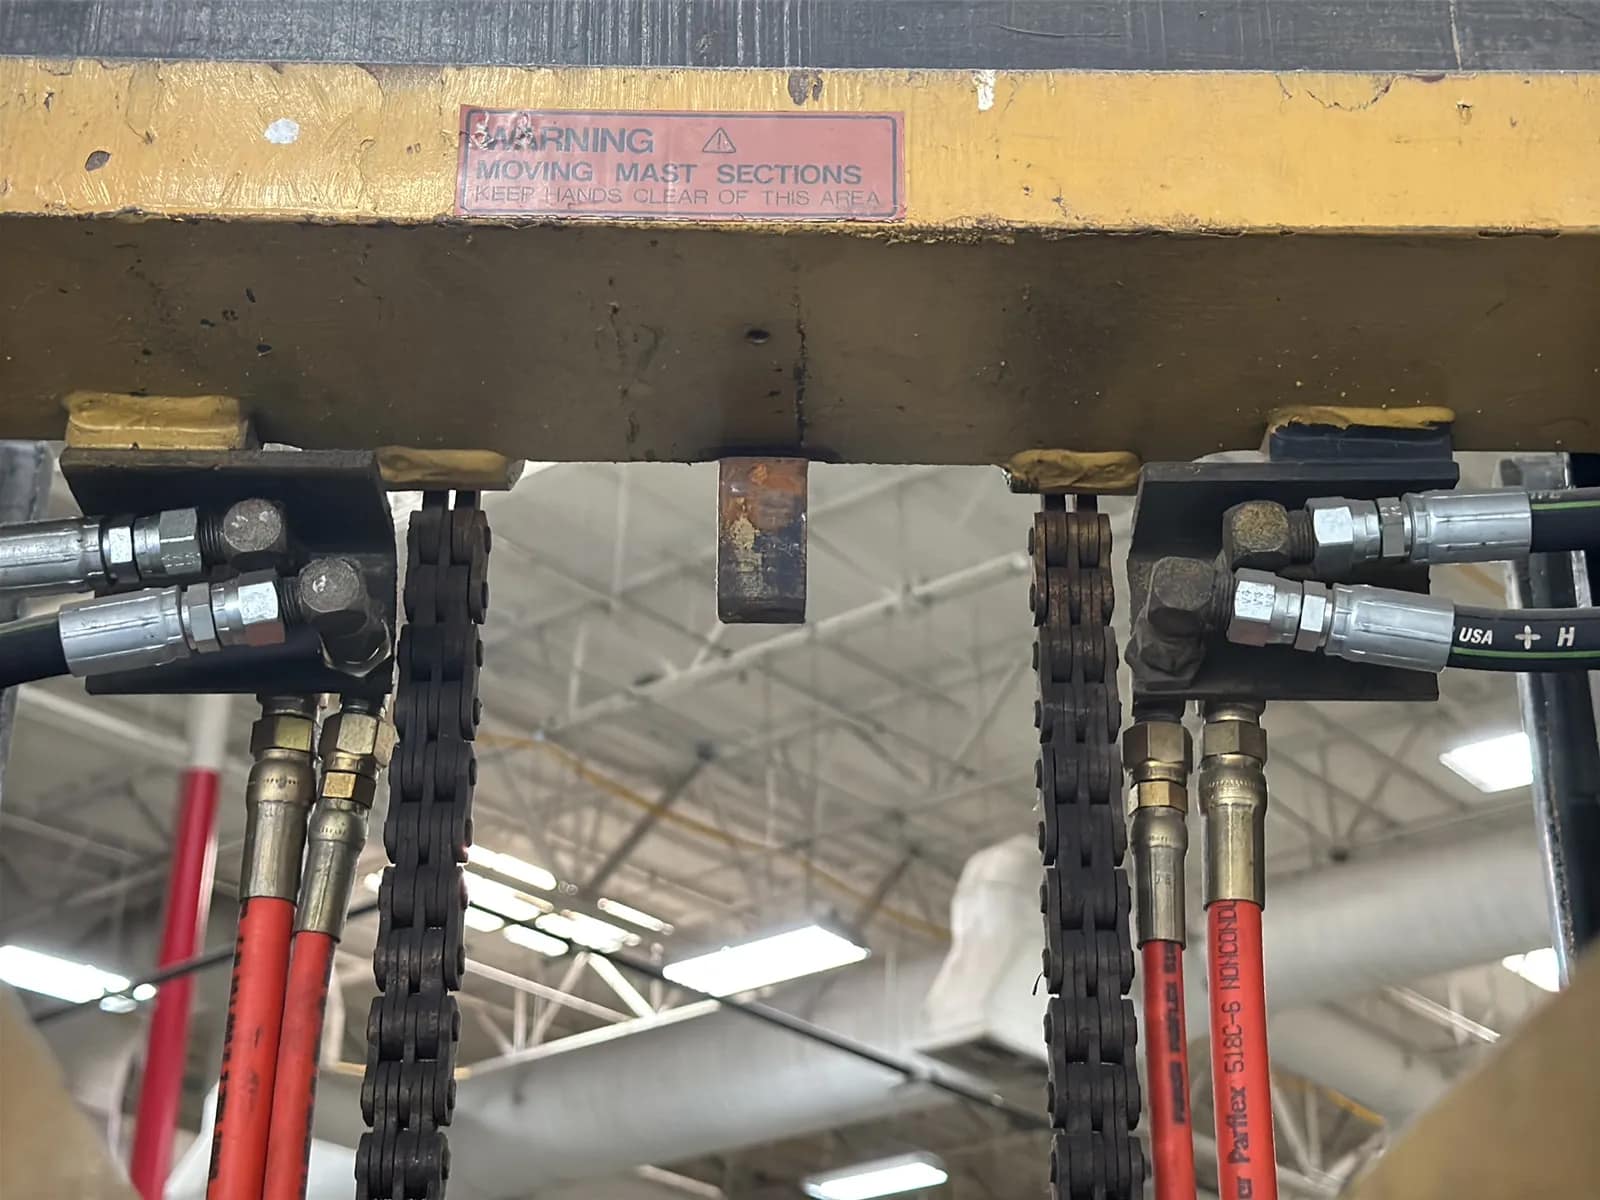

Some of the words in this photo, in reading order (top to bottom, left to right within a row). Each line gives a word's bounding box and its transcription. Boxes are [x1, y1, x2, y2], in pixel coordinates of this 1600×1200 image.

[482, 127, 654, 153] WARNING
[476, 160, 593, 182] MOVING
[615, 162, 698, 183] MAST
[717, 164, 862, 185] SECTIONS
[475, 185, 534, 203] KEEP
[546, 187, 623, 204] HANDS
[633, 188, 709, 206] CLEAR
[718, 189, 748, 205] OF
[763, 190, 810, 206] THIS
[820, 190, 880, 206] AREA
[1458, 626, 1494, 646] USA
[1557, 626, 1576, 648] H
[1221, 1001, 1244, 1074] 518C-6
[1226, 1086, 1250, 1165] Parflex
